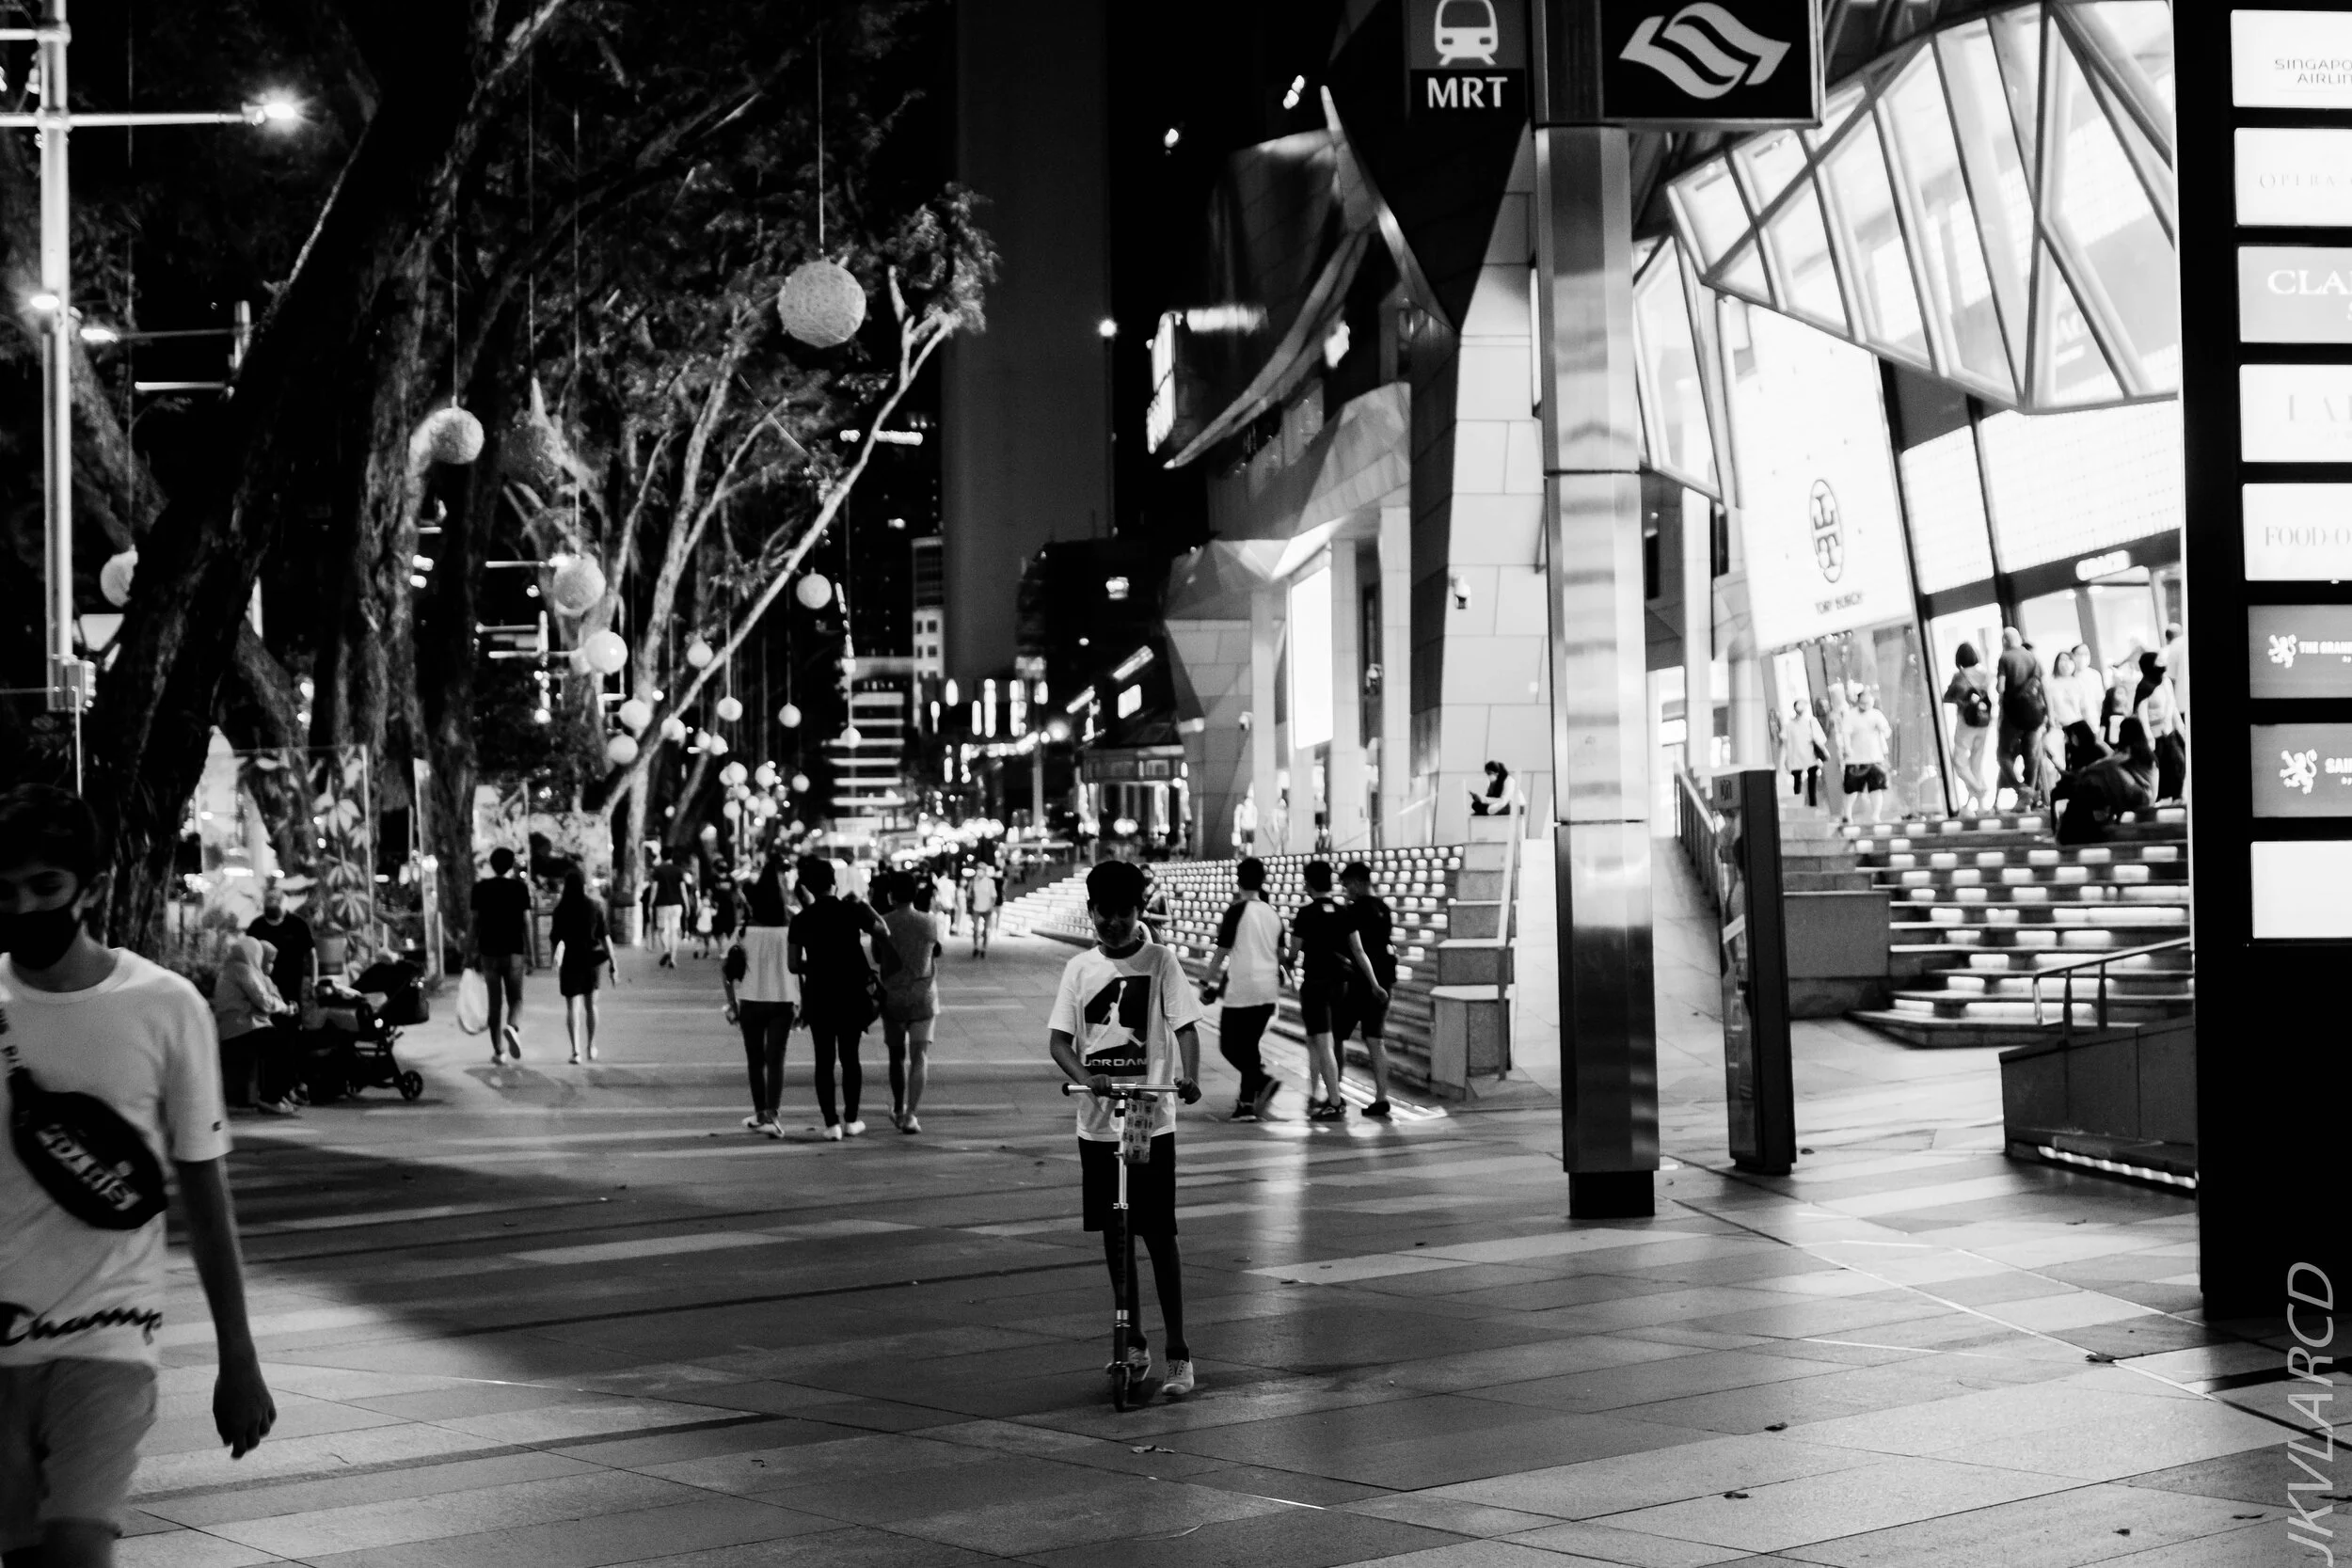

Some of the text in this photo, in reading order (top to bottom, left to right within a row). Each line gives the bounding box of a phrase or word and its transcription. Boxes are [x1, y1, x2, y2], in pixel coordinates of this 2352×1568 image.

[1427, 77, 1508, 109] MRT
[2266, 269, 2352, 295] CLA
[2263, 524, 2328, 547] FOOD
[1081, 1058, 1148, 1067] JORDAN
